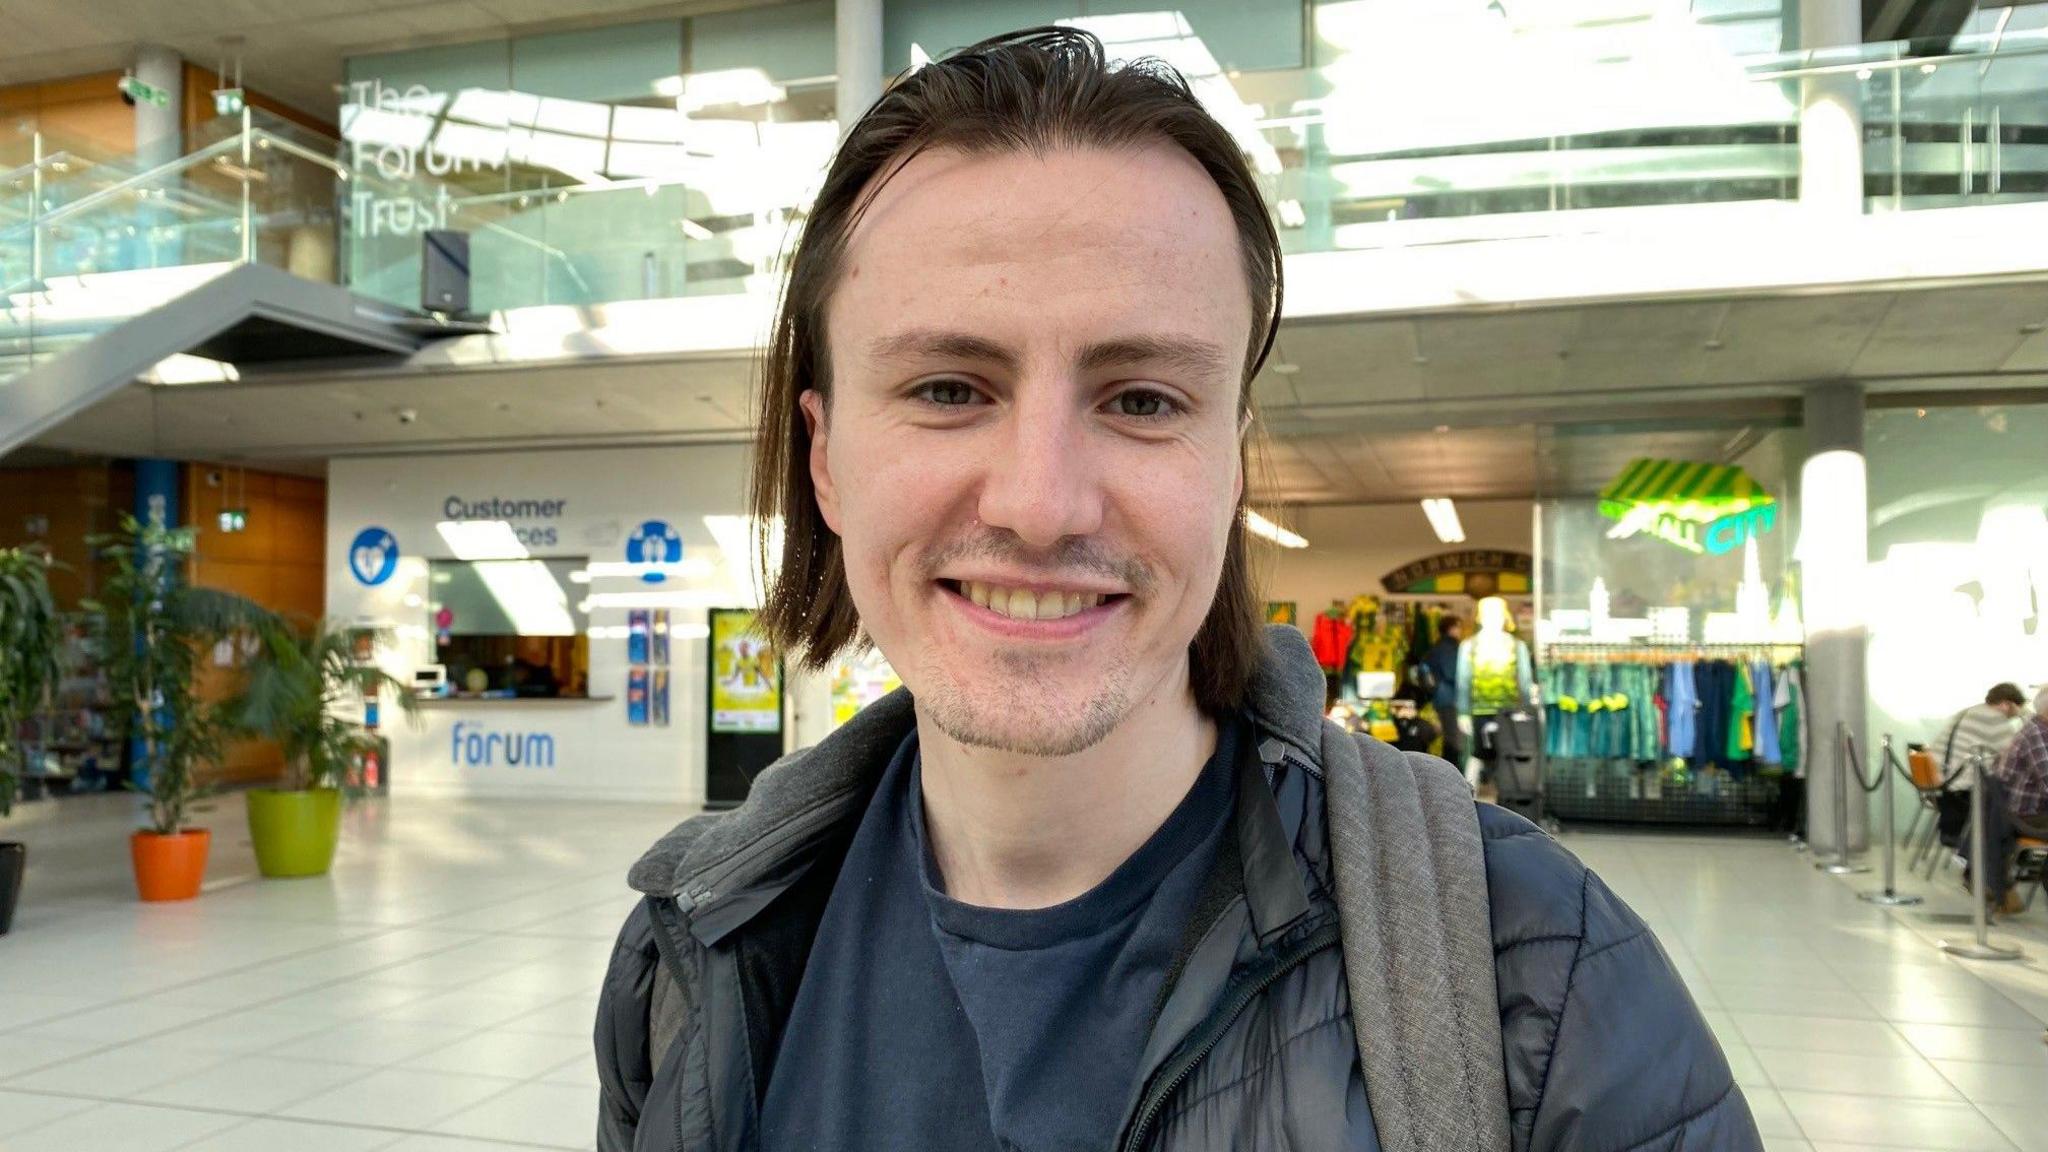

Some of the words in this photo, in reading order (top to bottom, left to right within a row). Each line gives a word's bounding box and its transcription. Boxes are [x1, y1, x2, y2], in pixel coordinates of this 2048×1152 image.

[352, 78, 432, 115] The
[353, 184, 450, 238] Trust
[444, 496, 566, 519] Customer
